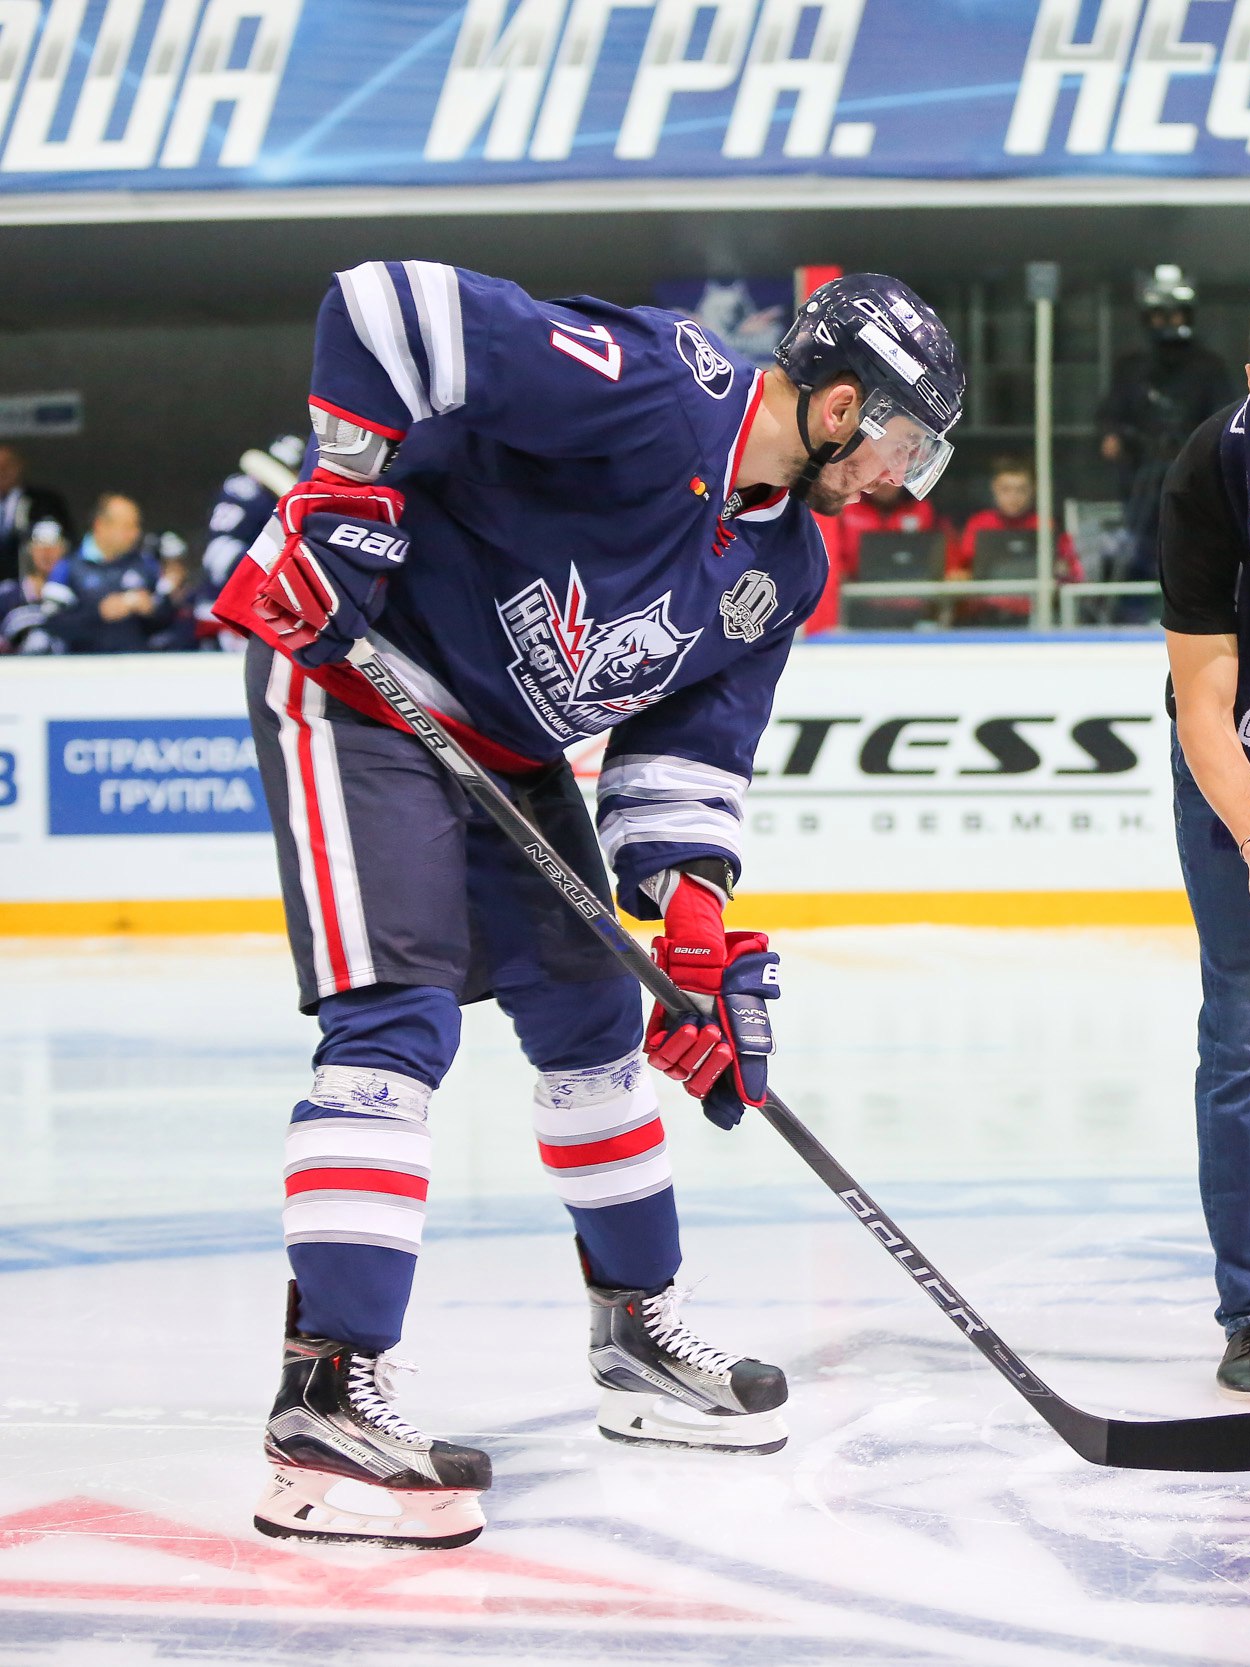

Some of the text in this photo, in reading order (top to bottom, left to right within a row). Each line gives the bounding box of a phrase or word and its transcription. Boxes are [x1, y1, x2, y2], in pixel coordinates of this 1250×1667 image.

[424, 0, 876, 161] ИГРА.
[359, 662, 448, 749] BAUER
[100, 777, 256, 814] ГРУППА
[524, 843, 600, 919] NEXUS
[674, 946, 711, 955] BAUER
[838, 1188, 990, 1337] BAUER
[331, 1435, 367, 1461] BAUER
